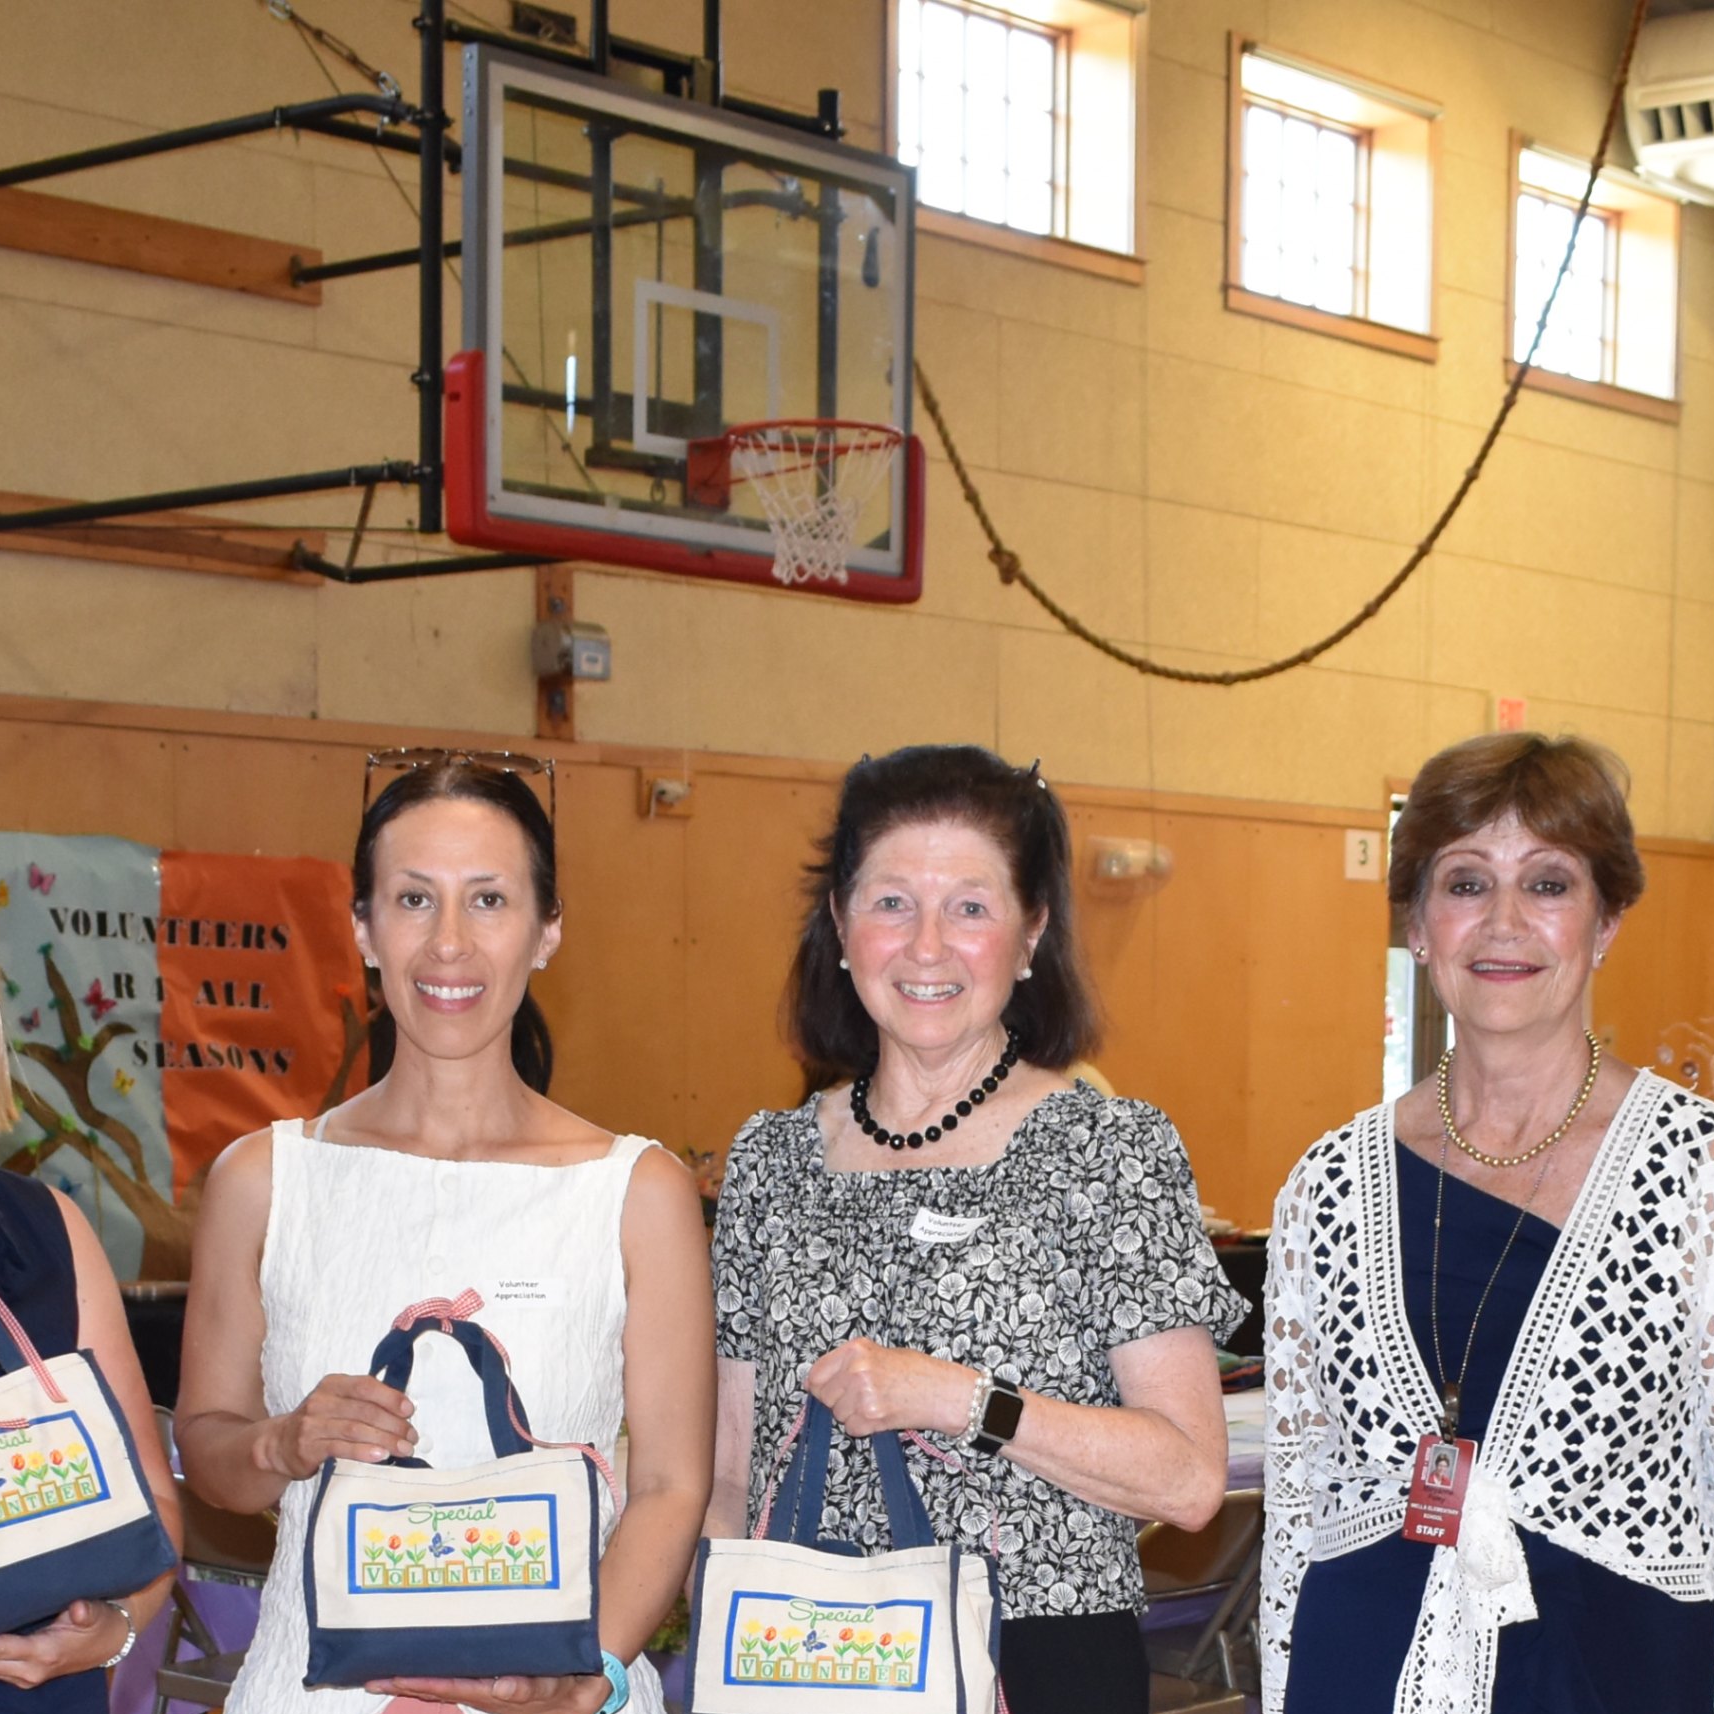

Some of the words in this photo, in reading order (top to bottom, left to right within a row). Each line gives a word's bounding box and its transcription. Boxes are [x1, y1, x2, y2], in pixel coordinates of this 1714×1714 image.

[1358, 840, 1368, 865] 3
[49, 908, 290, 951] VOLUNTEERS
[113, 973, 136, 999] R
[196, 980, 270, 1009] ALL
[132, 1040, 292, 1074] SEASONS
[927, 1216, 967, 1228] Volunteer
[407, 1499, 497, 1532] Special
[1416, 1525, 1445, 1538] STAFF
[365, 1565, 542, 1585] VOLUNTEER
[789, 1600, 875, 1628] Special
[740, 1657, 909, 1682] VOLUNTEER
